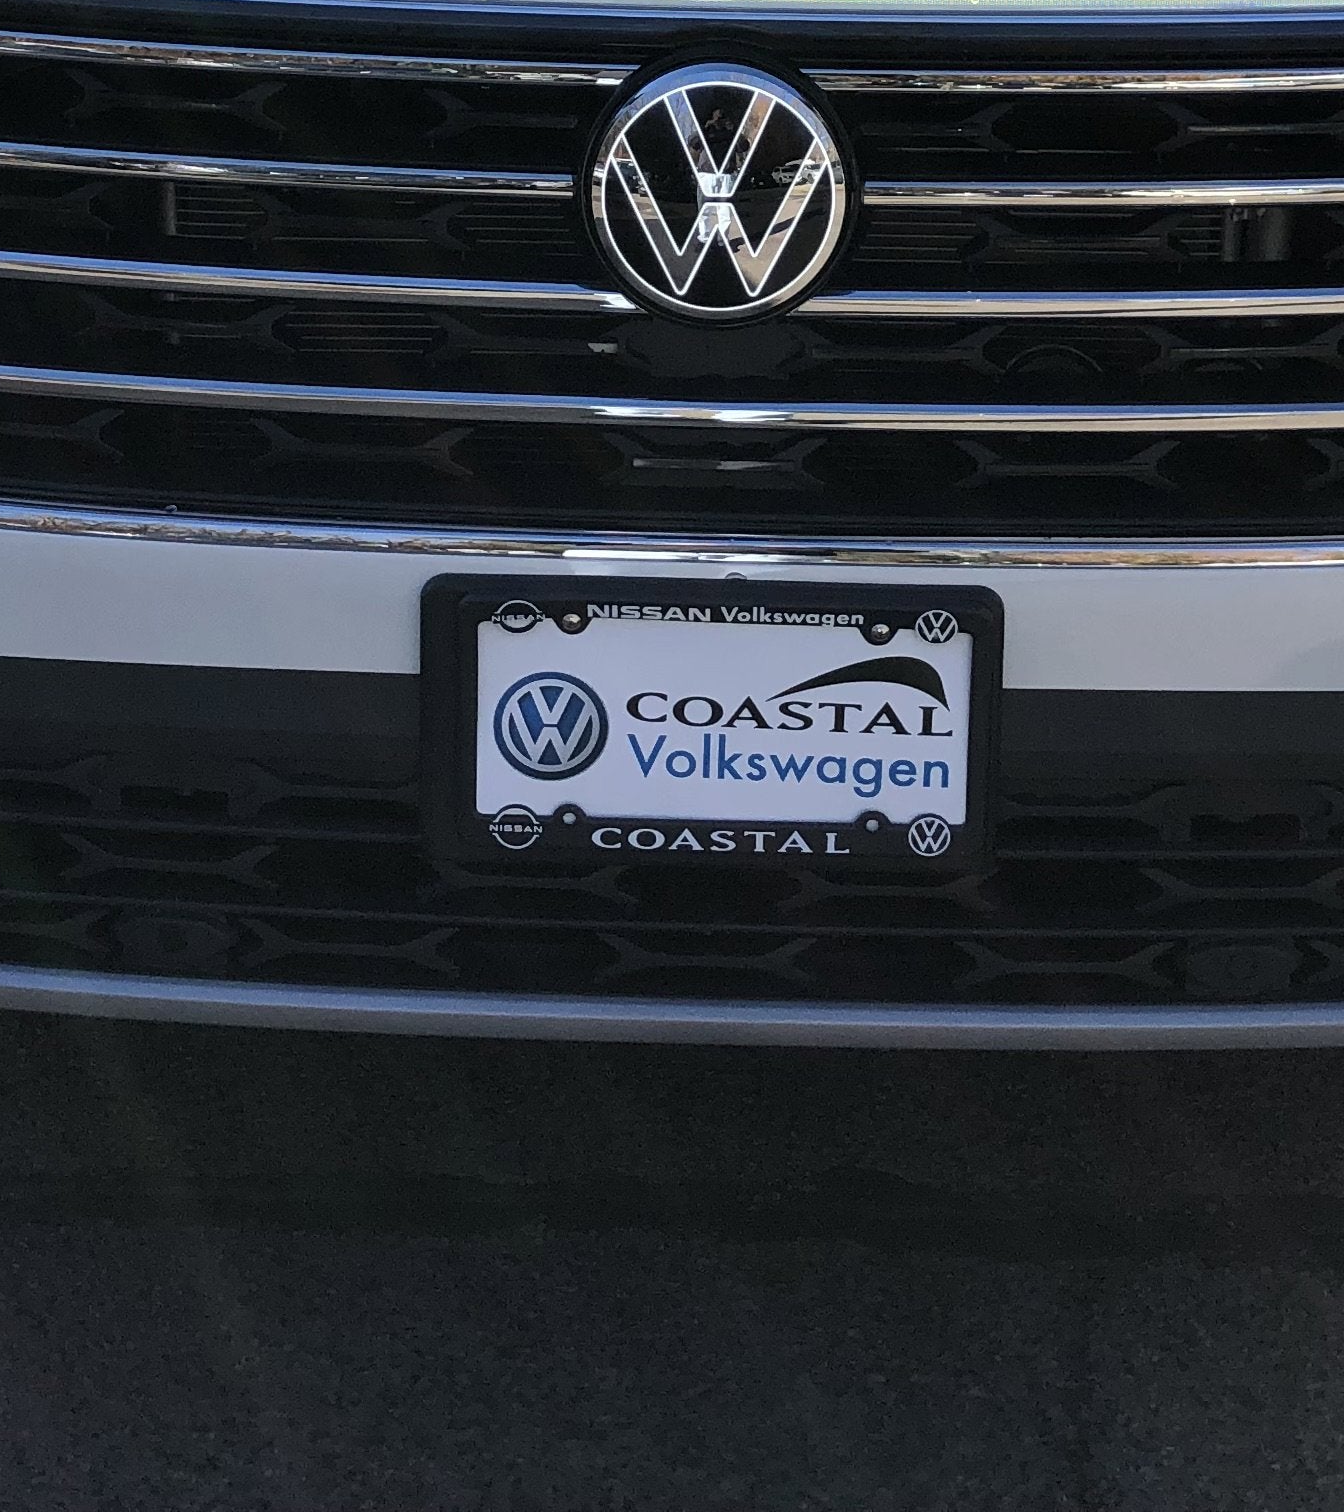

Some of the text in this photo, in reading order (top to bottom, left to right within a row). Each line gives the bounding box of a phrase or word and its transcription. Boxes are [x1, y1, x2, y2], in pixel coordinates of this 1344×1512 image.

[607, 85, 831, 303] VW
[586, 604, 864, 626] NISSAN Volkswagen
[917, 611, 957, 643] VW
[499, 677, 604, 775] VW
[626, 692, 953, 737] COASTAL
[626, 733, 950, 797] Volkswagen
[591, 827, 850, 855] COASTAL
[909, 817, 950, 856] VW
